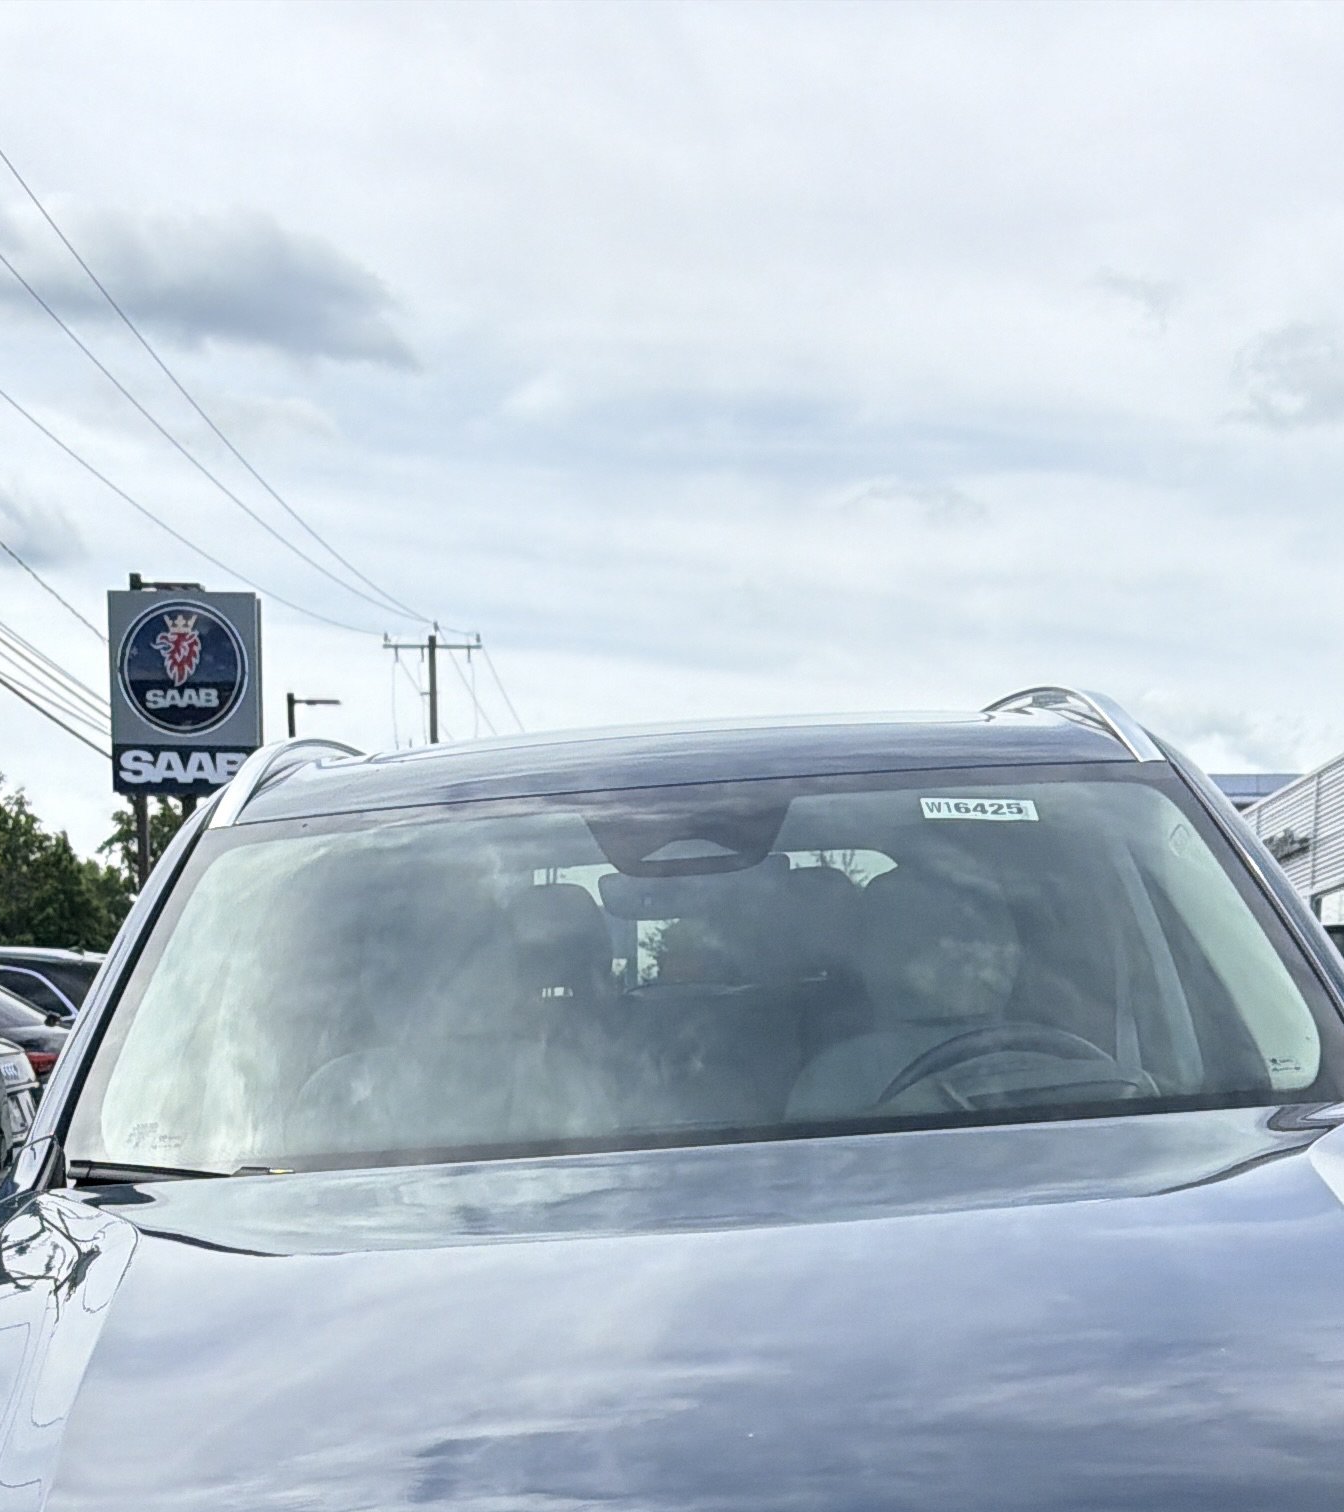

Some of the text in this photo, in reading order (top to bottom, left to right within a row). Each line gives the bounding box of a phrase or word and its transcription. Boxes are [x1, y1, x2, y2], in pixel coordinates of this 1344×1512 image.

[145, 688, 219, 709] SAAB
[119, 749, 249, 785] SAAB
[924, 800, 1024, 816] W16425
